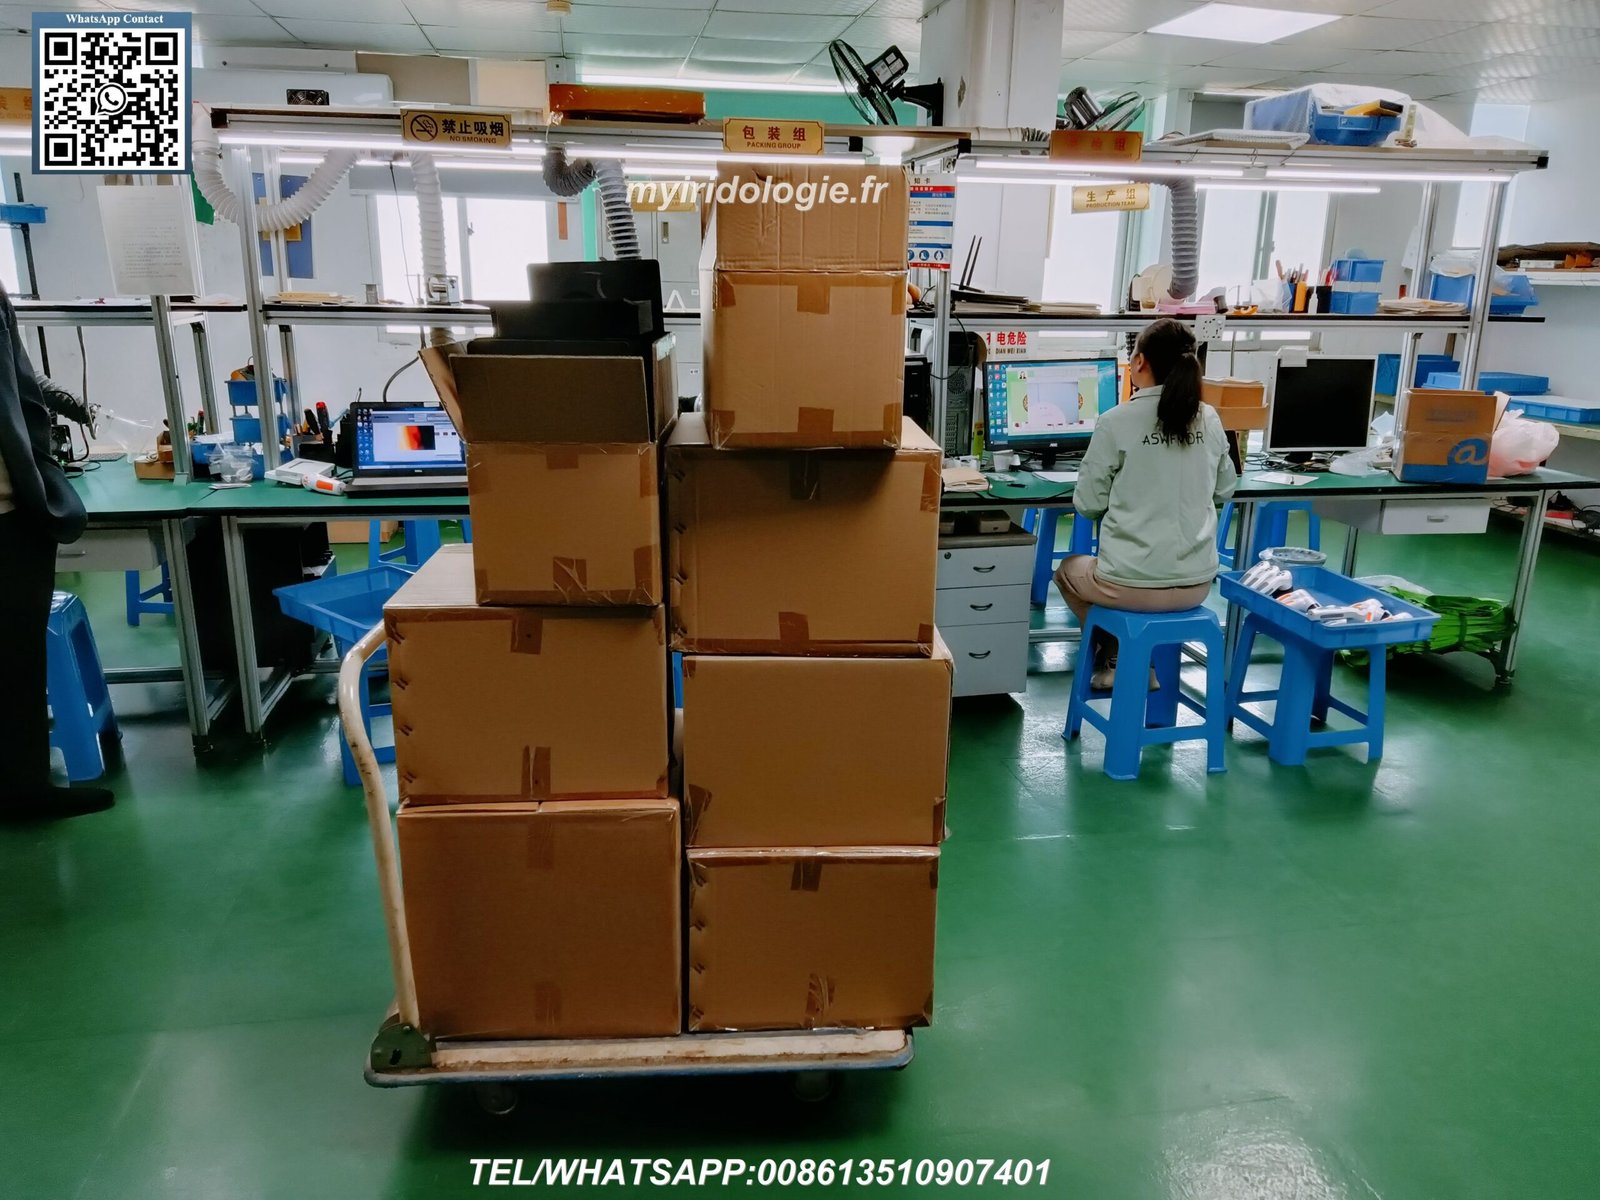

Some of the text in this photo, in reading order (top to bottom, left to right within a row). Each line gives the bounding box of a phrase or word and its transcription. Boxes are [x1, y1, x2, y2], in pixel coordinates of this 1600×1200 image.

[442, 119, 504, 136] 禁止吸烟
[742, 125, 806, 142] 包装组
[746, 141, 776, 149] PACKING
[1086, 188, 1136, 203] 生产组
